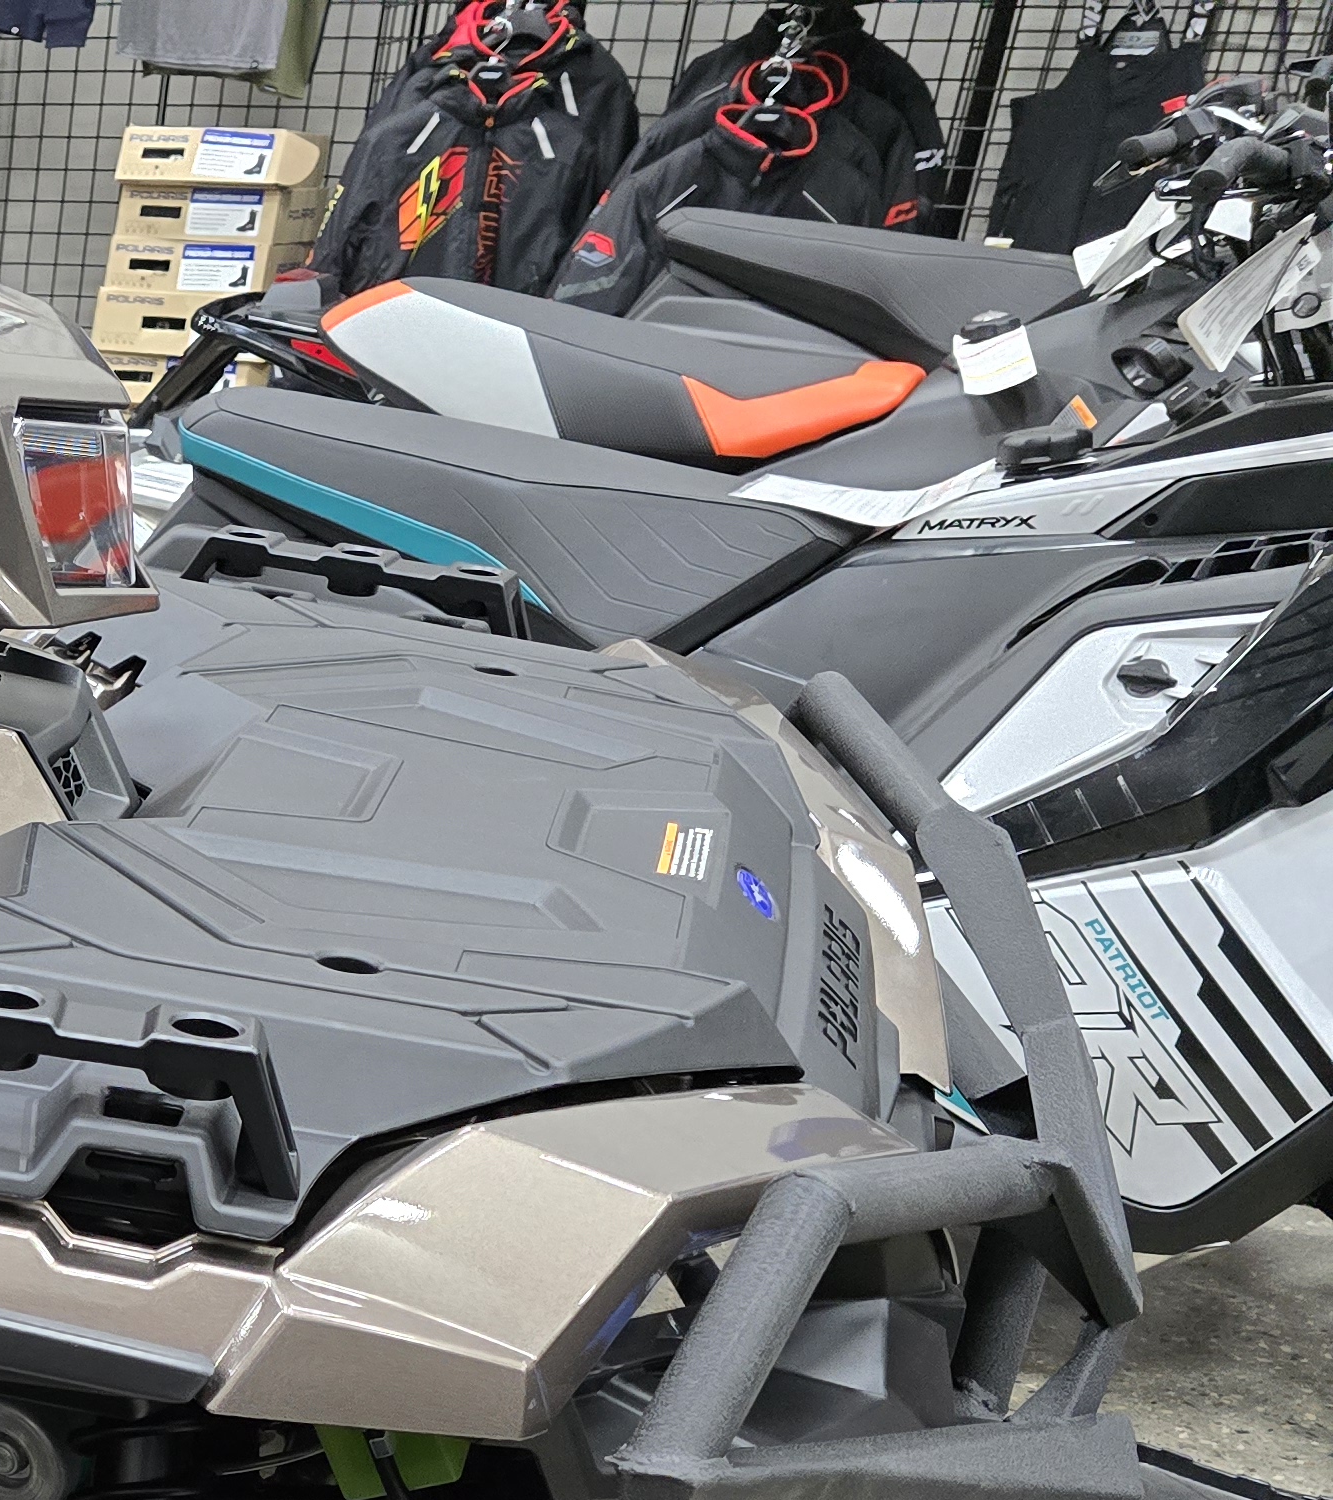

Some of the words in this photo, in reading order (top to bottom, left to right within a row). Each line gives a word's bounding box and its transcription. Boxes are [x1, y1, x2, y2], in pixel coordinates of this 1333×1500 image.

[129, 133, 190, 143] POLARIS
[116, 243, 175, 255] POLARIS
[106, 294, 165, 306] POLARIS
[917, 515, 1037, 534] MATRYX
[1084, 918, 1170, 1021] PATRIOT
[818, 903, 861, 1070] POLARIS
